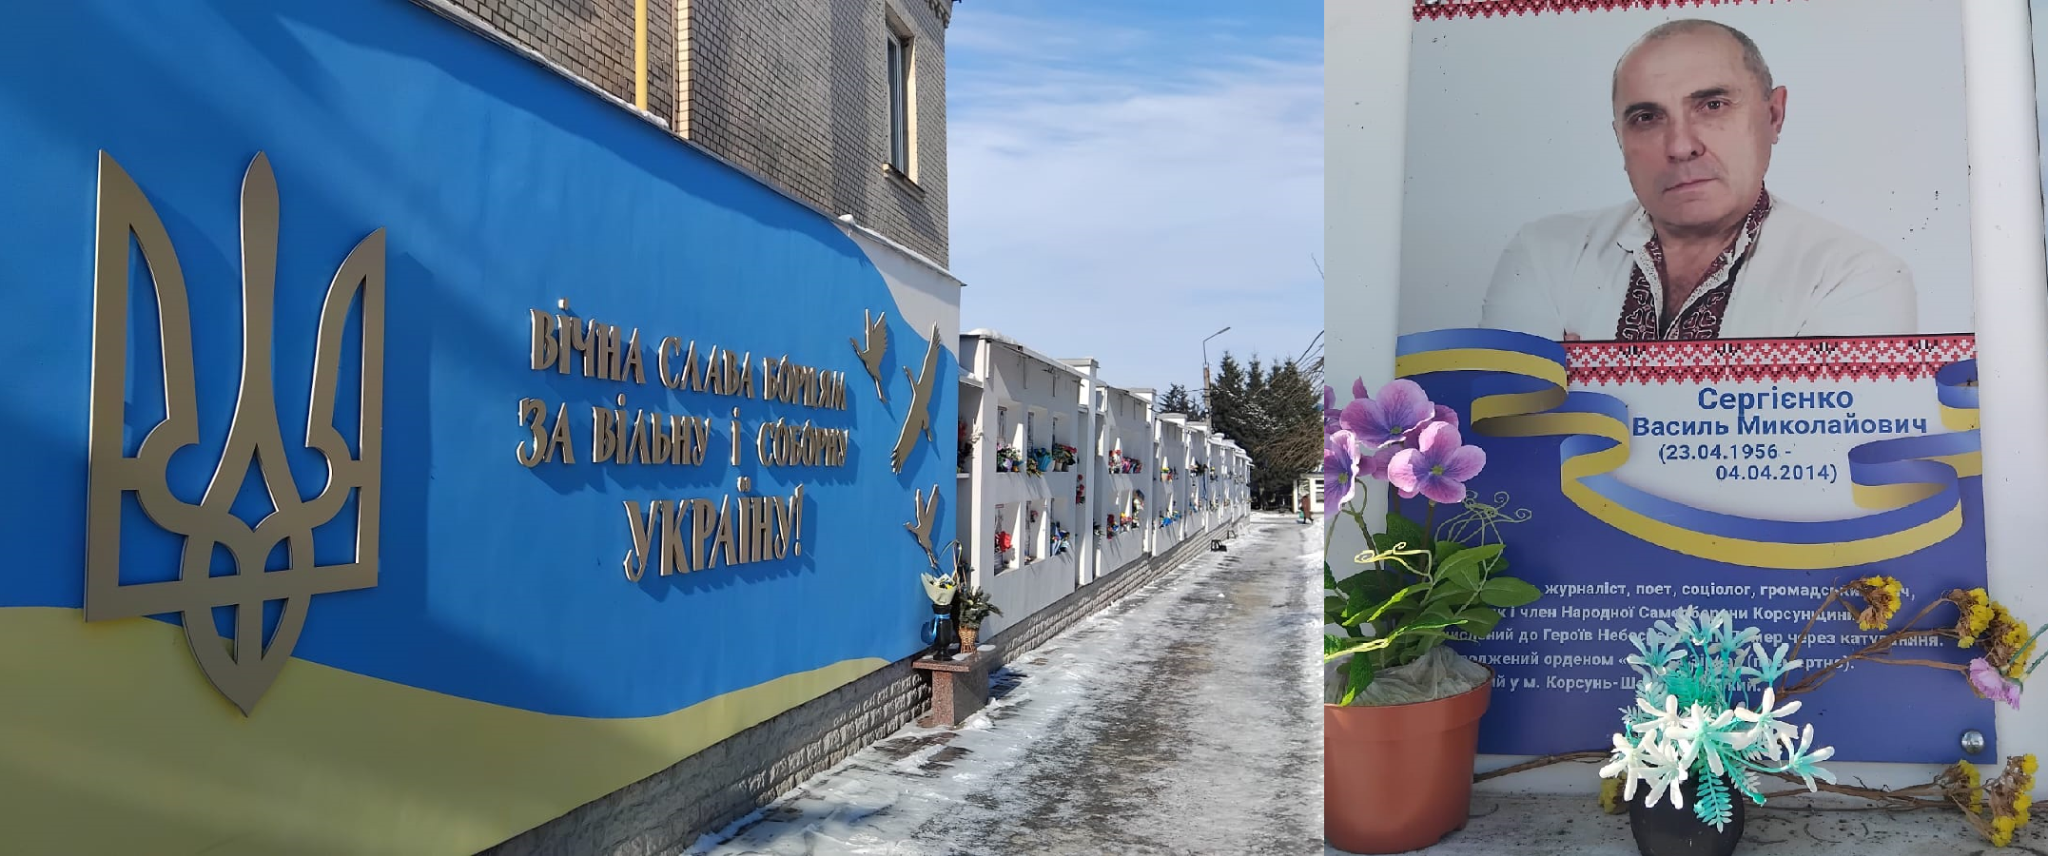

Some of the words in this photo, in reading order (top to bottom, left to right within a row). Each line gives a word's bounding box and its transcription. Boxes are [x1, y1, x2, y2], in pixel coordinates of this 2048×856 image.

[658, 335, 756, 399] СЛАВА
[763, 353, 848, 411] БОРЦЯМ
[1697, 386, 1854, 415] Сергієнко
[516, 397, 576, 468] ЗА
[757, 416, 849, 468] СОБОРНУ
[1632, 416, 1729, 437] Василь
[1737, 412, 1928, 436] Миколайович
[1659, 443, 1778, 464] (23.04.1956
[1716, 464, 1838, 484] 04.04.2014)
[623, 476, 805, 583] УКРАЇНУ!
[1544, 581, 1631, 598] журналіст,
[1636, 584, 1677, 598] поет,
[1681, 582, 1756, 599] соціолог,
[1520, 608, 1557, 618] член
[1561, 604, 1634, 621] Народної
[1518, 631, 1538, 643] до
[1543, 628, 1594, 642] Героїв
[1788, 634, 1836, 648] через
[1544, 655, 1614, 668] орденом
[1510, 677, 1520, 692] у
[1523, 678, 1540, 689] м.
